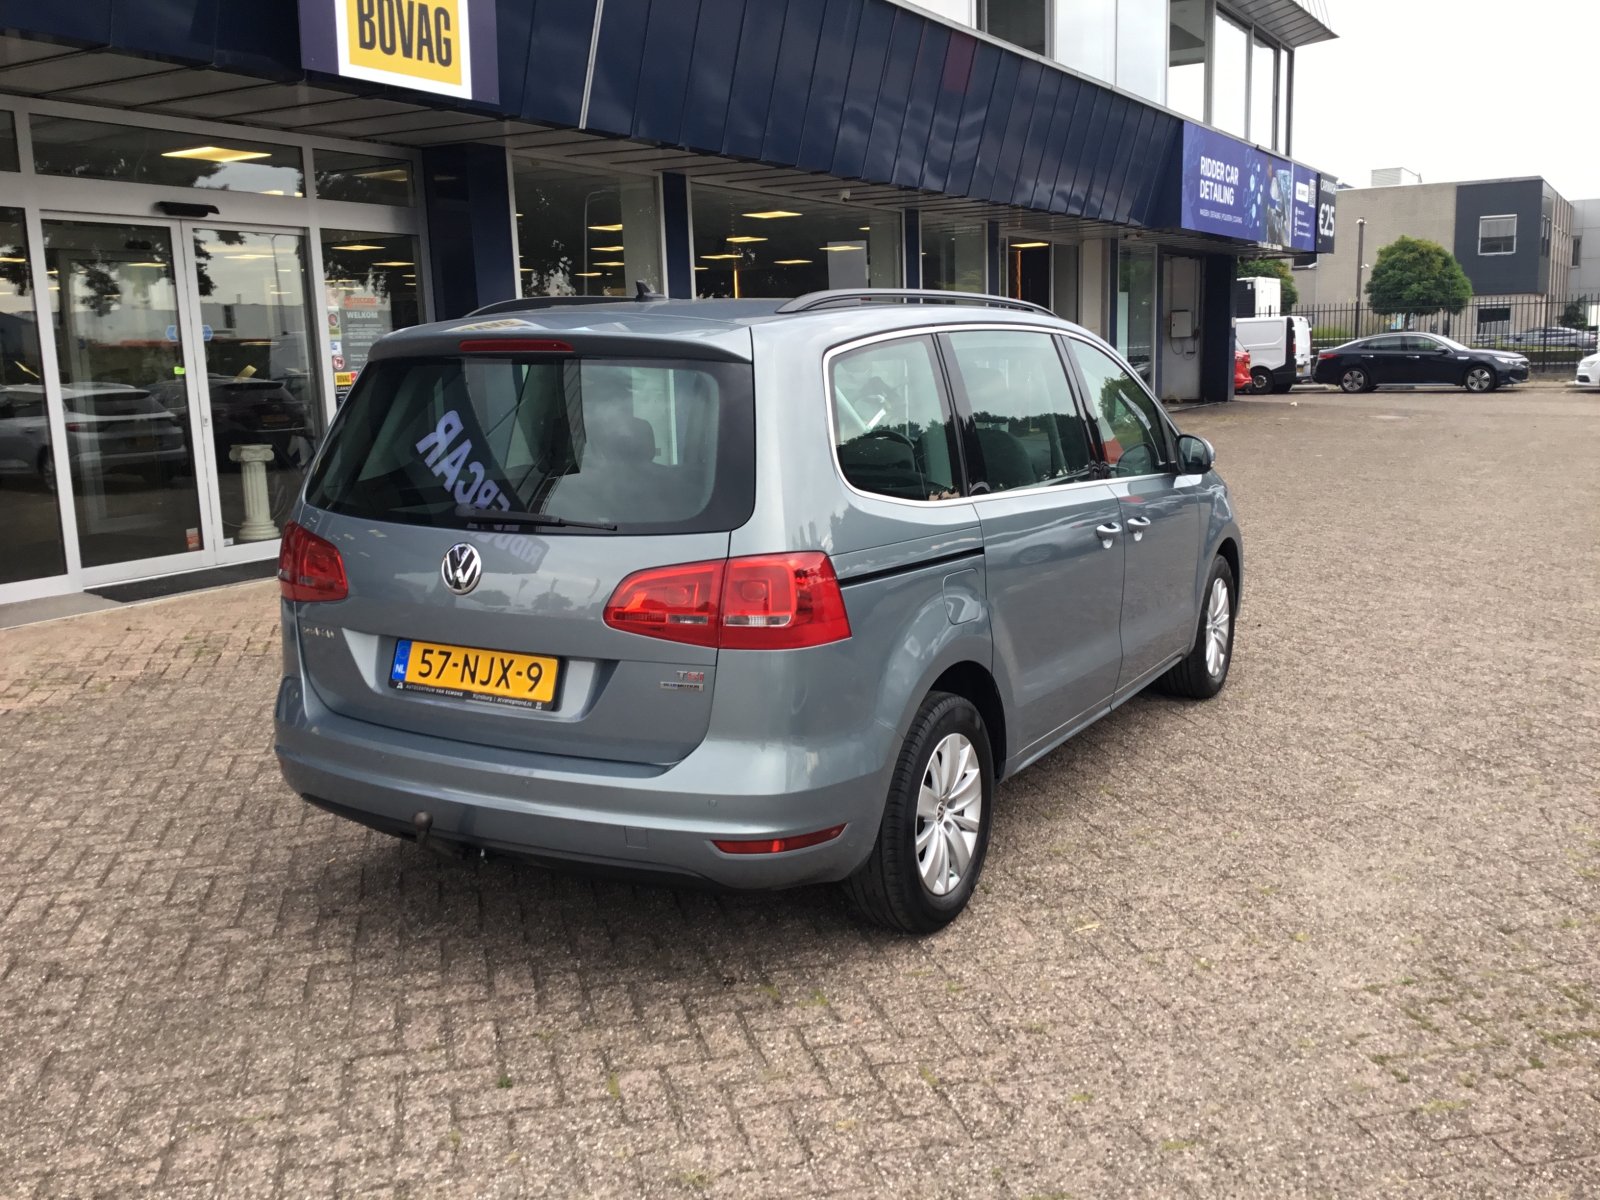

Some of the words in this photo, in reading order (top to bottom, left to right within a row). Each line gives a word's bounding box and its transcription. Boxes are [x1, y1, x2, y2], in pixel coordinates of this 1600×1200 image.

[357, 0, 452, 67] BOVAG
[1200, 155, 1225, 182] RIDDER
[1225, 164, 1239, 186] CAR
[1200, 179, 1235, 206] DETAILING
[1319, 203, 1335, 237] €25
[346, 311, 378, 319] WELKOM
[394, 664, 406, 674] NL
[418, 648, 543, 693] 57-NJX-9
[677, 670, 704, 682] TSI
